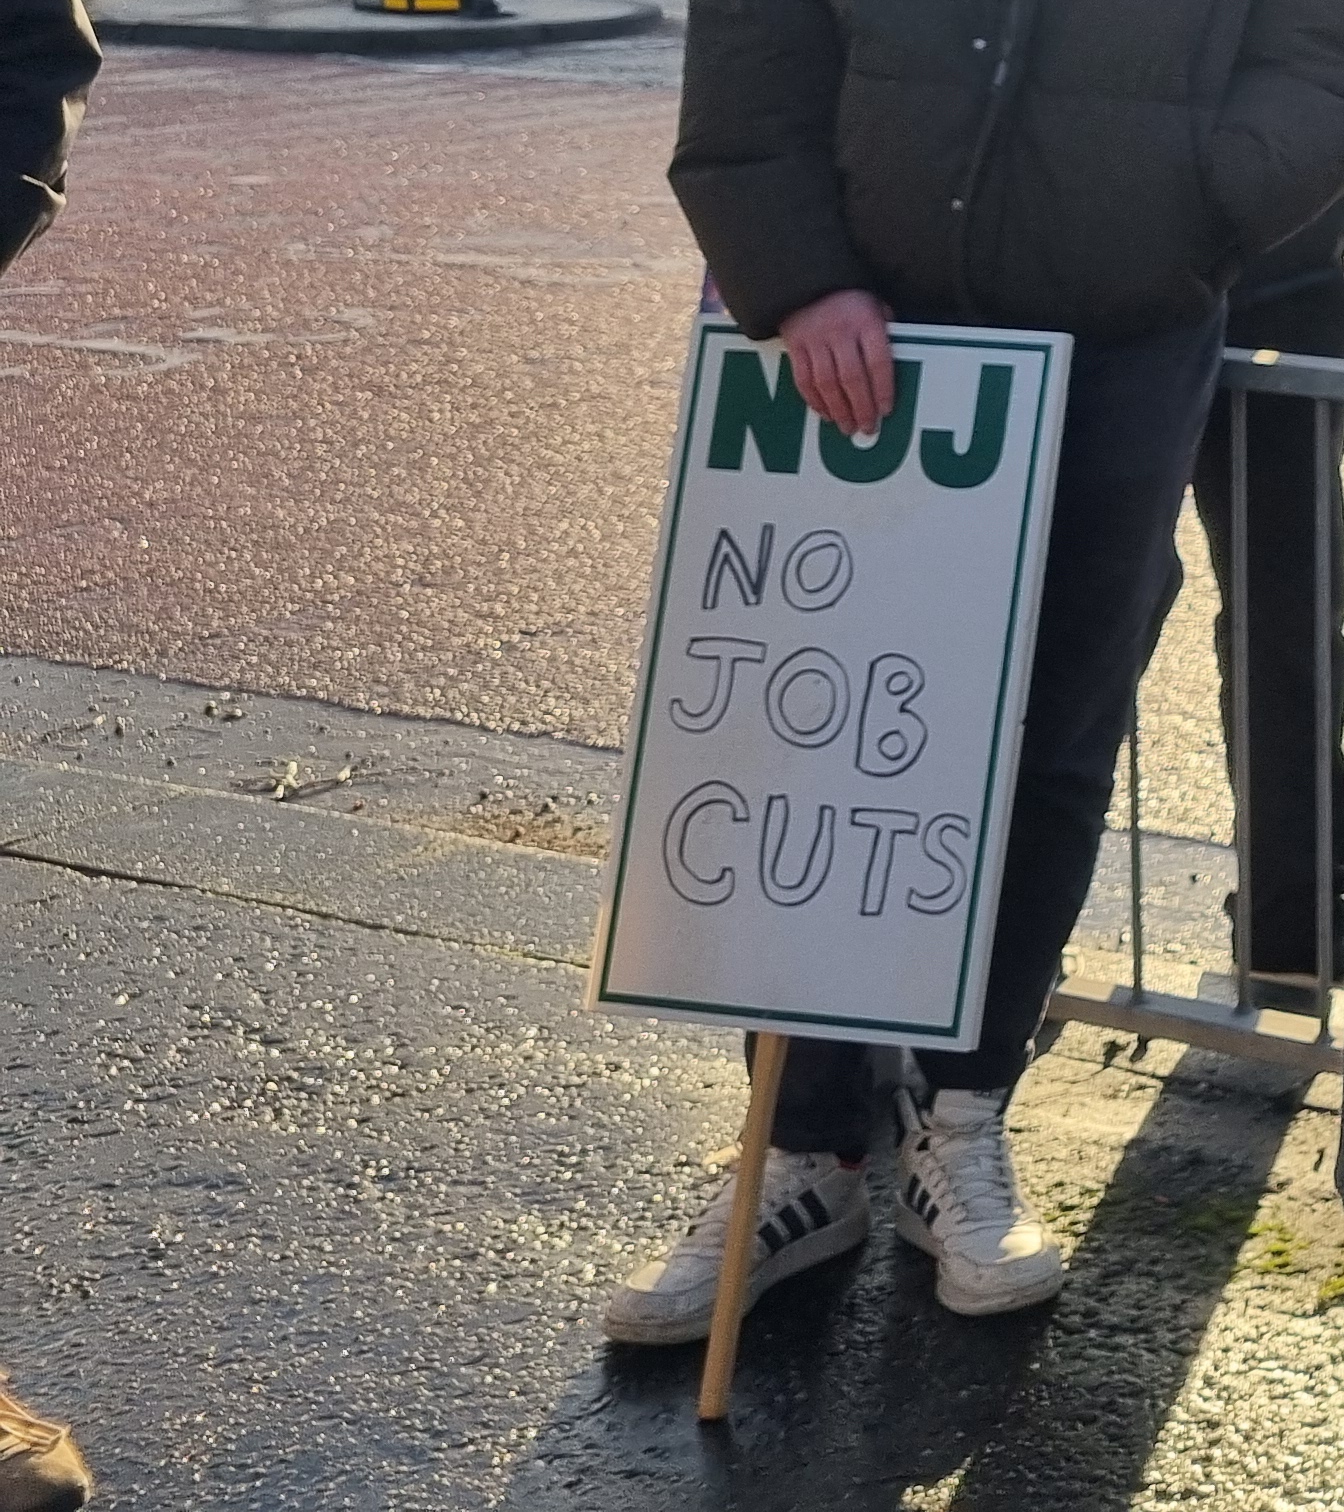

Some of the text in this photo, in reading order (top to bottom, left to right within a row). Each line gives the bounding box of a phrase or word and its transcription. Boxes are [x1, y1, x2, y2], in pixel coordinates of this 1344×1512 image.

[707, 350, 1014, 489] NUJ
[702, 524, 853, 611] NO
[670, 637, 928, 778] JOB
[663, 780, 971, 916] CUTS
